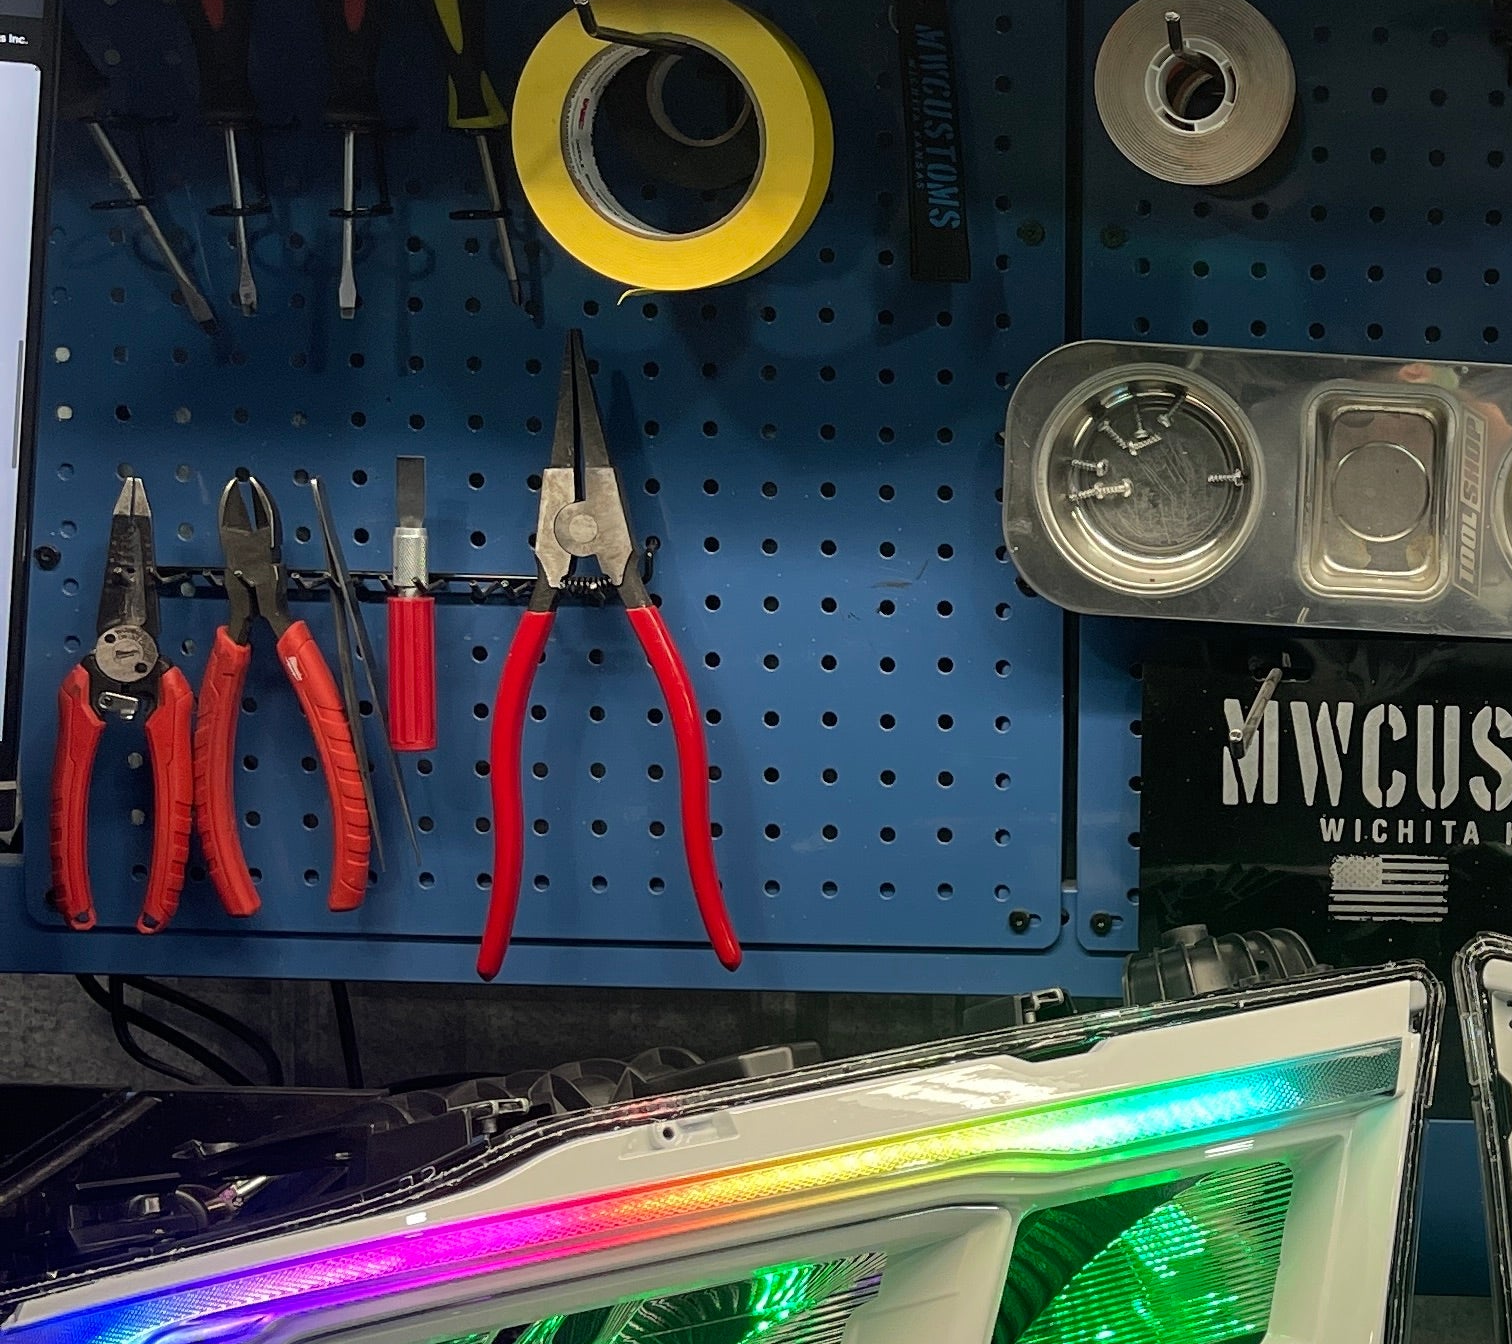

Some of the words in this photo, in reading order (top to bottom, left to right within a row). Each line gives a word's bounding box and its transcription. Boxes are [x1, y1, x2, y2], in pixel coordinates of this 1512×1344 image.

[914, 23, 961, 230] MWCUSTOMS
[1462, 419, 1483, 507] SHOP
[1459, 512, 1478, 584] TOOL
[1320, 817, 1480, 846] WICHITA
